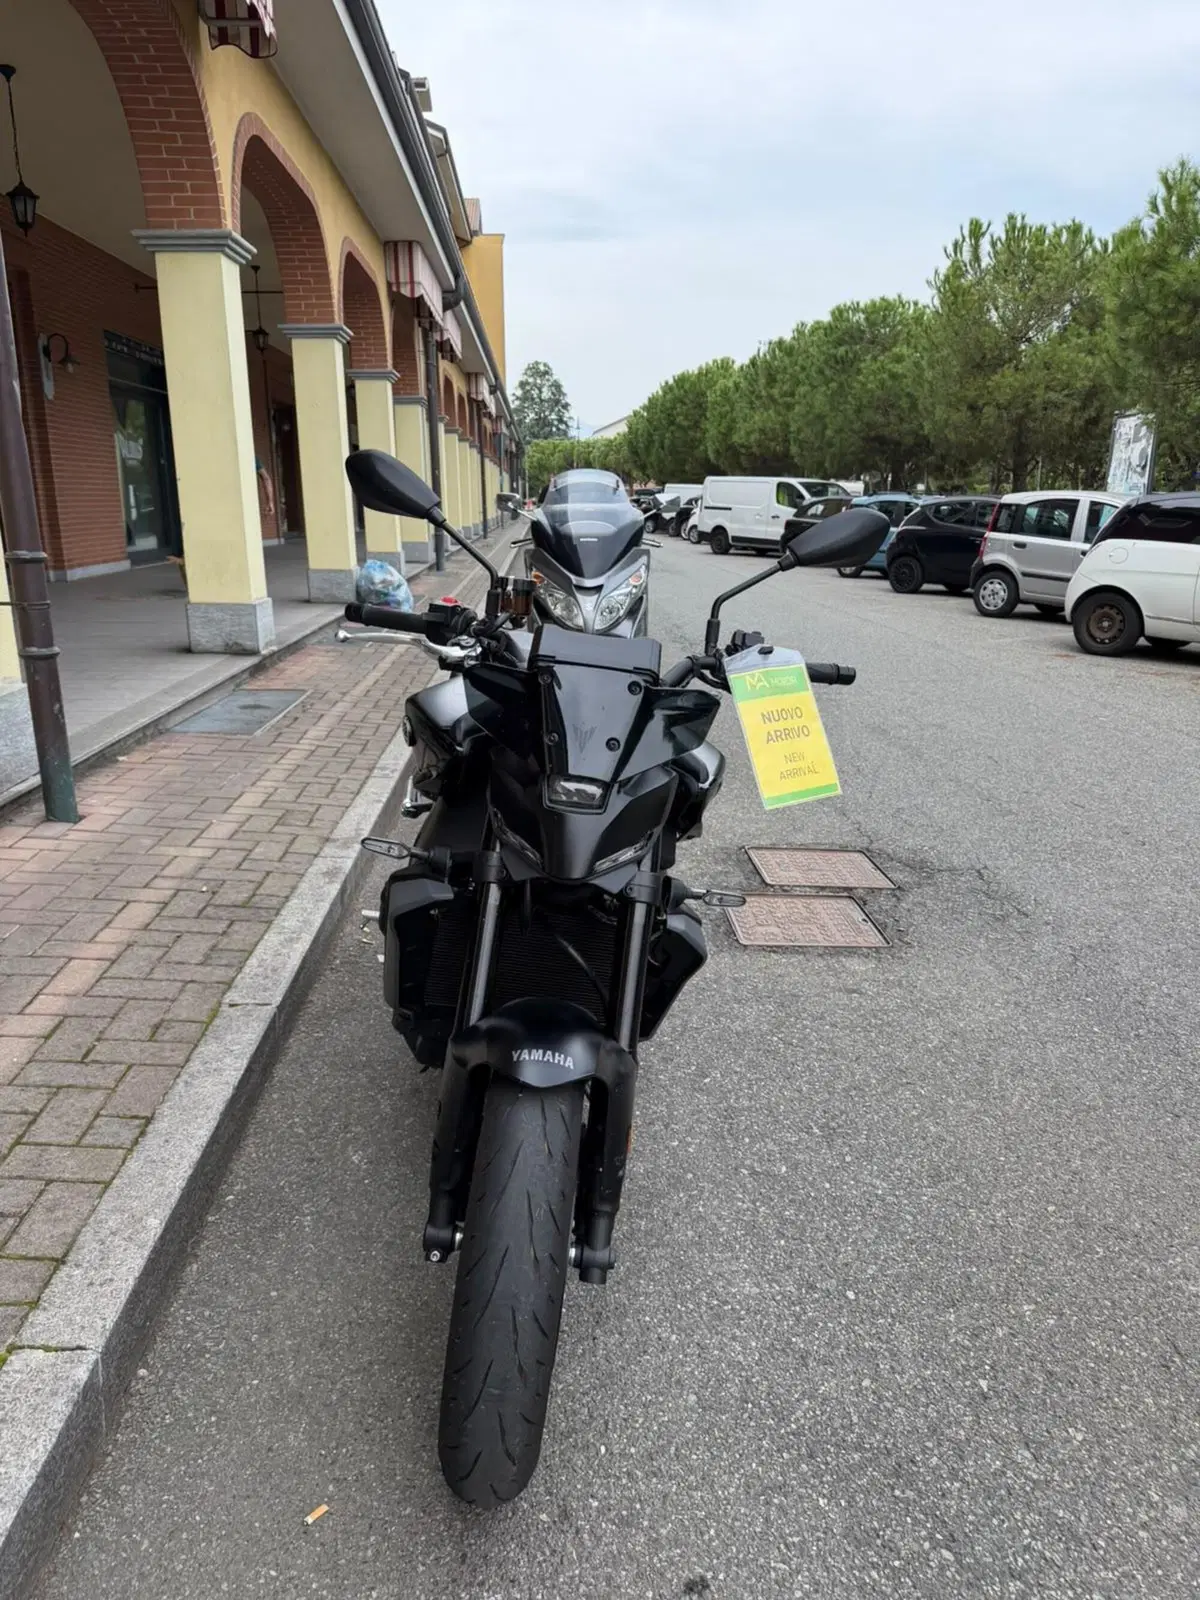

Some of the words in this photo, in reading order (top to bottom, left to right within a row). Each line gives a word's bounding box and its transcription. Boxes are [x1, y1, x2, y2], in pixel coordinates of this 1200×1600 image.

[761, 706, 803, 724] NUOVO
[766, 724, 810, 744] ARRIVO
[784, 751, 805, 764] NEW
[780, 760, 820, 781] ARRIVAL
[511, 1048, 574, 1070] YAMAHA
